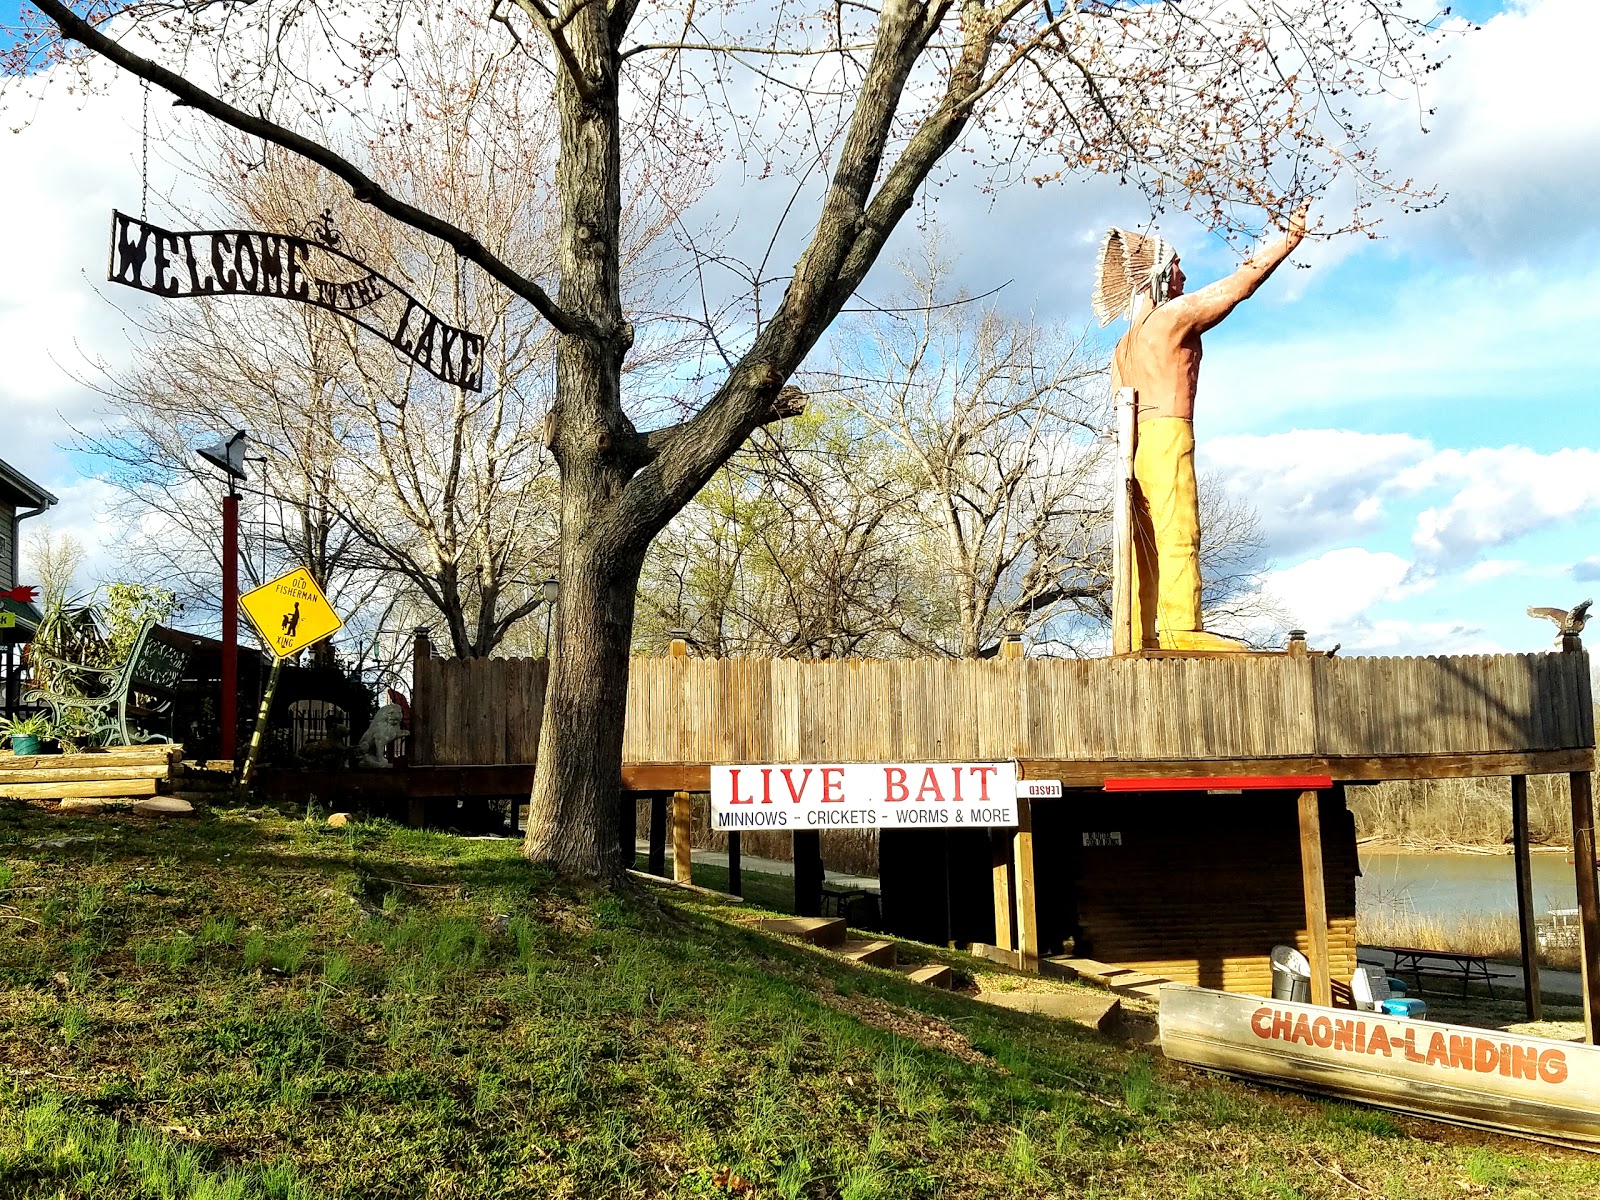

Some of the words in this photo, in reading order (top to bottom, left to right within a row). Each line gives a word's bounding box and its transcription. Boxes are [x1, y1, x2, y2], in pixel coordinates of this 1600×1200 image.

[118, 216, 310, 299] WELCOME
[341, 274, 384, 309] THE
[392, 299, 484, 387] LAKE
[275, 585, 318, 603] FISHERMAN
[293, 579, 307, 590] OLD
[275, 636, 293, 648] XING
[729, 768, 845, 805] LIVE
[883, 767, 998, 803] BAIT
[1029, 785, 1060, 795] LEASED
[718, 811, 787, 827] MINNOWS
[807, 810, 876, 825] CRICKETS
[896, 809, 949, 823] WORMS
[955, 809, 964, 823] &
[970, 808, 1011, 822] MORE
